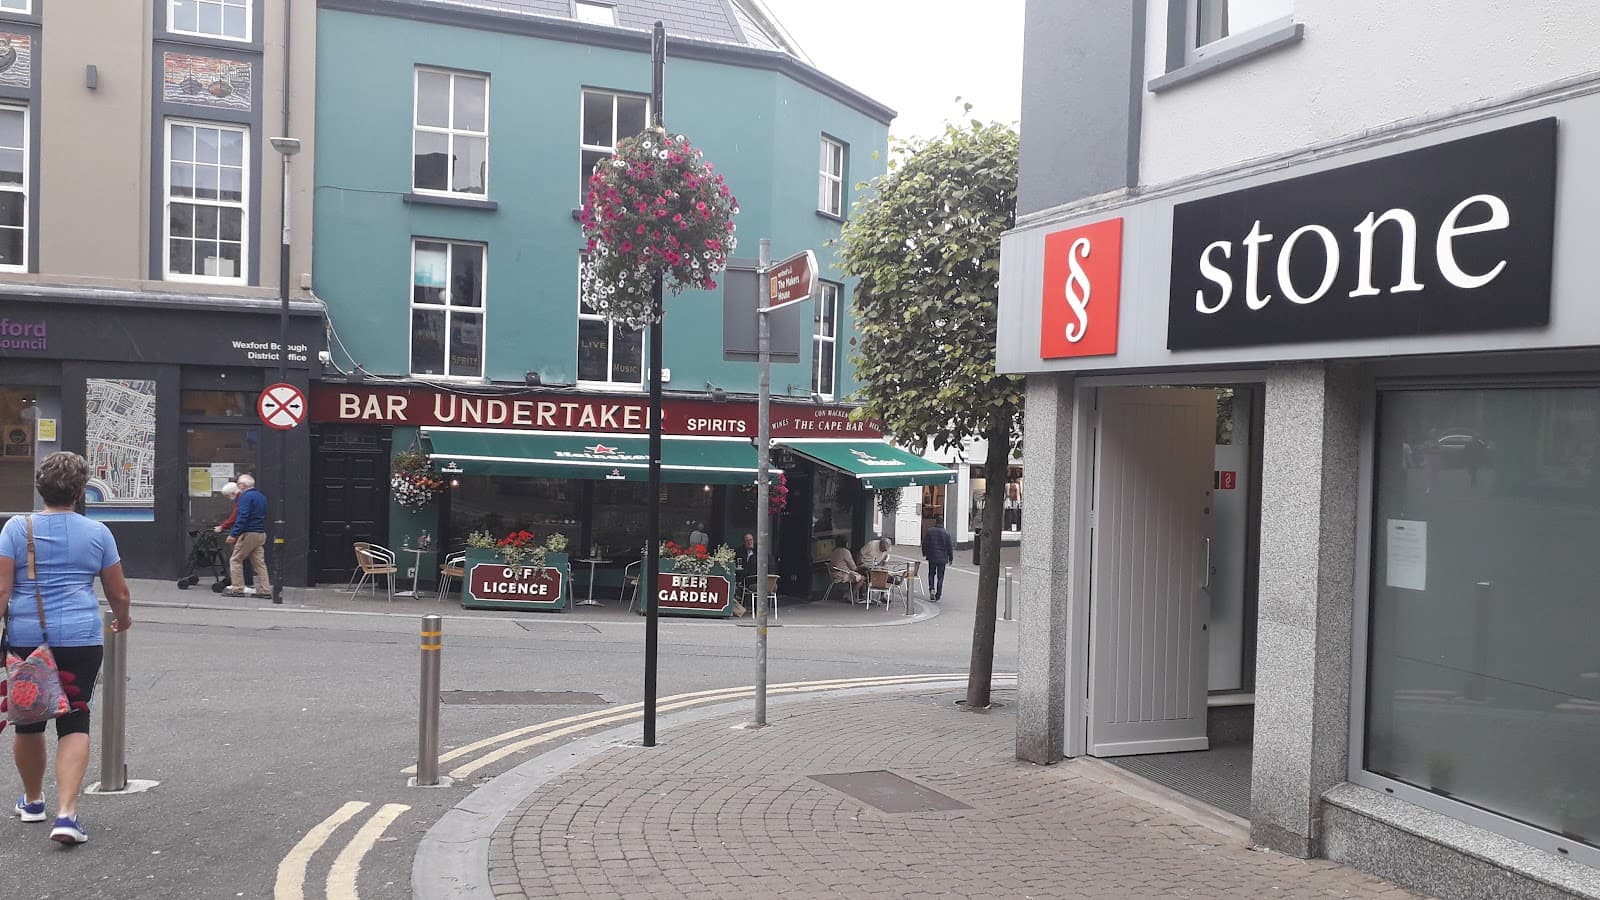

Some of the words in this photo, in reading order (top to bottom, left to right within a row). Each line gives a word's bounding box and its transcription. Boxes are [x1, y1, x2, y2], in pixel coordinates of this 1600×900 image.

[1195, 194, 1510, 314] stone
[0, 338, 47, 350] ouncil
[232, 341, 269, 350] Wexford
[270, 342, 308, 353] Boough
[247, 351, 280, 361] District
[287, 353, 308, 362] ffice
[339, 393, 408, 421] BAR
[687, 417, 747, 433] SPIRITS
[772, 418, 789, 430] WINES
[795, 418, 815, 430] THE
[818, 421, 843, 431] CAPE
[846, 421, 864, 432] BAR
[503, 567, 532, 580] OF
[483, 581, 548, 596] LICENCE
[672, 575, 708, 589] BEER
[658, 589, 719, 604] GARDEN
